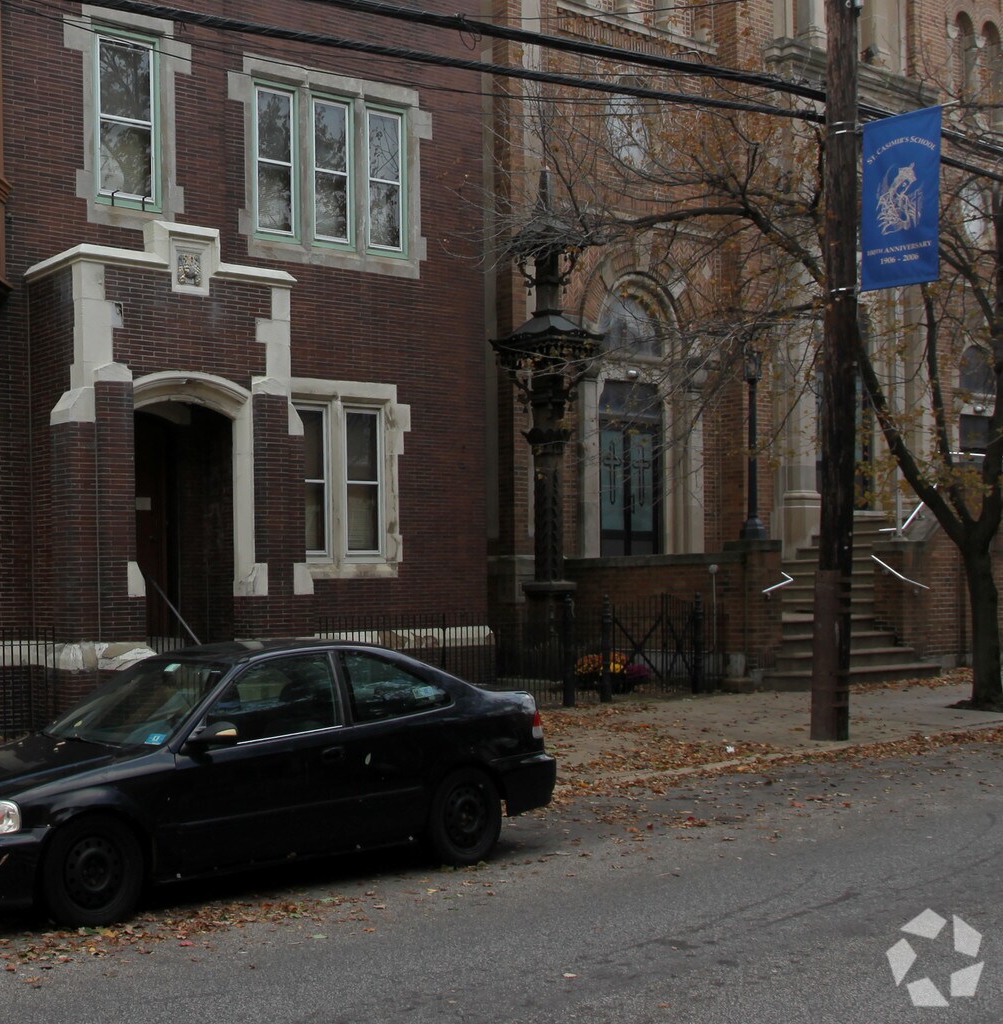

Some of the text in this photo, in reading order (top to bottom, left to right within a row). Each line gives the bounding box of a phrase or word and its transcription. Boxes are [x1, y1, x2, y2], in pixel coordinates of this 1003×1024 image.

[910, 136, 936, 151] SCHOOL
[884, 240, 932, 253] ANNIVERSARY
[880, 256, 896, 265] 1906
[902, 253, 919, 262] 2006
